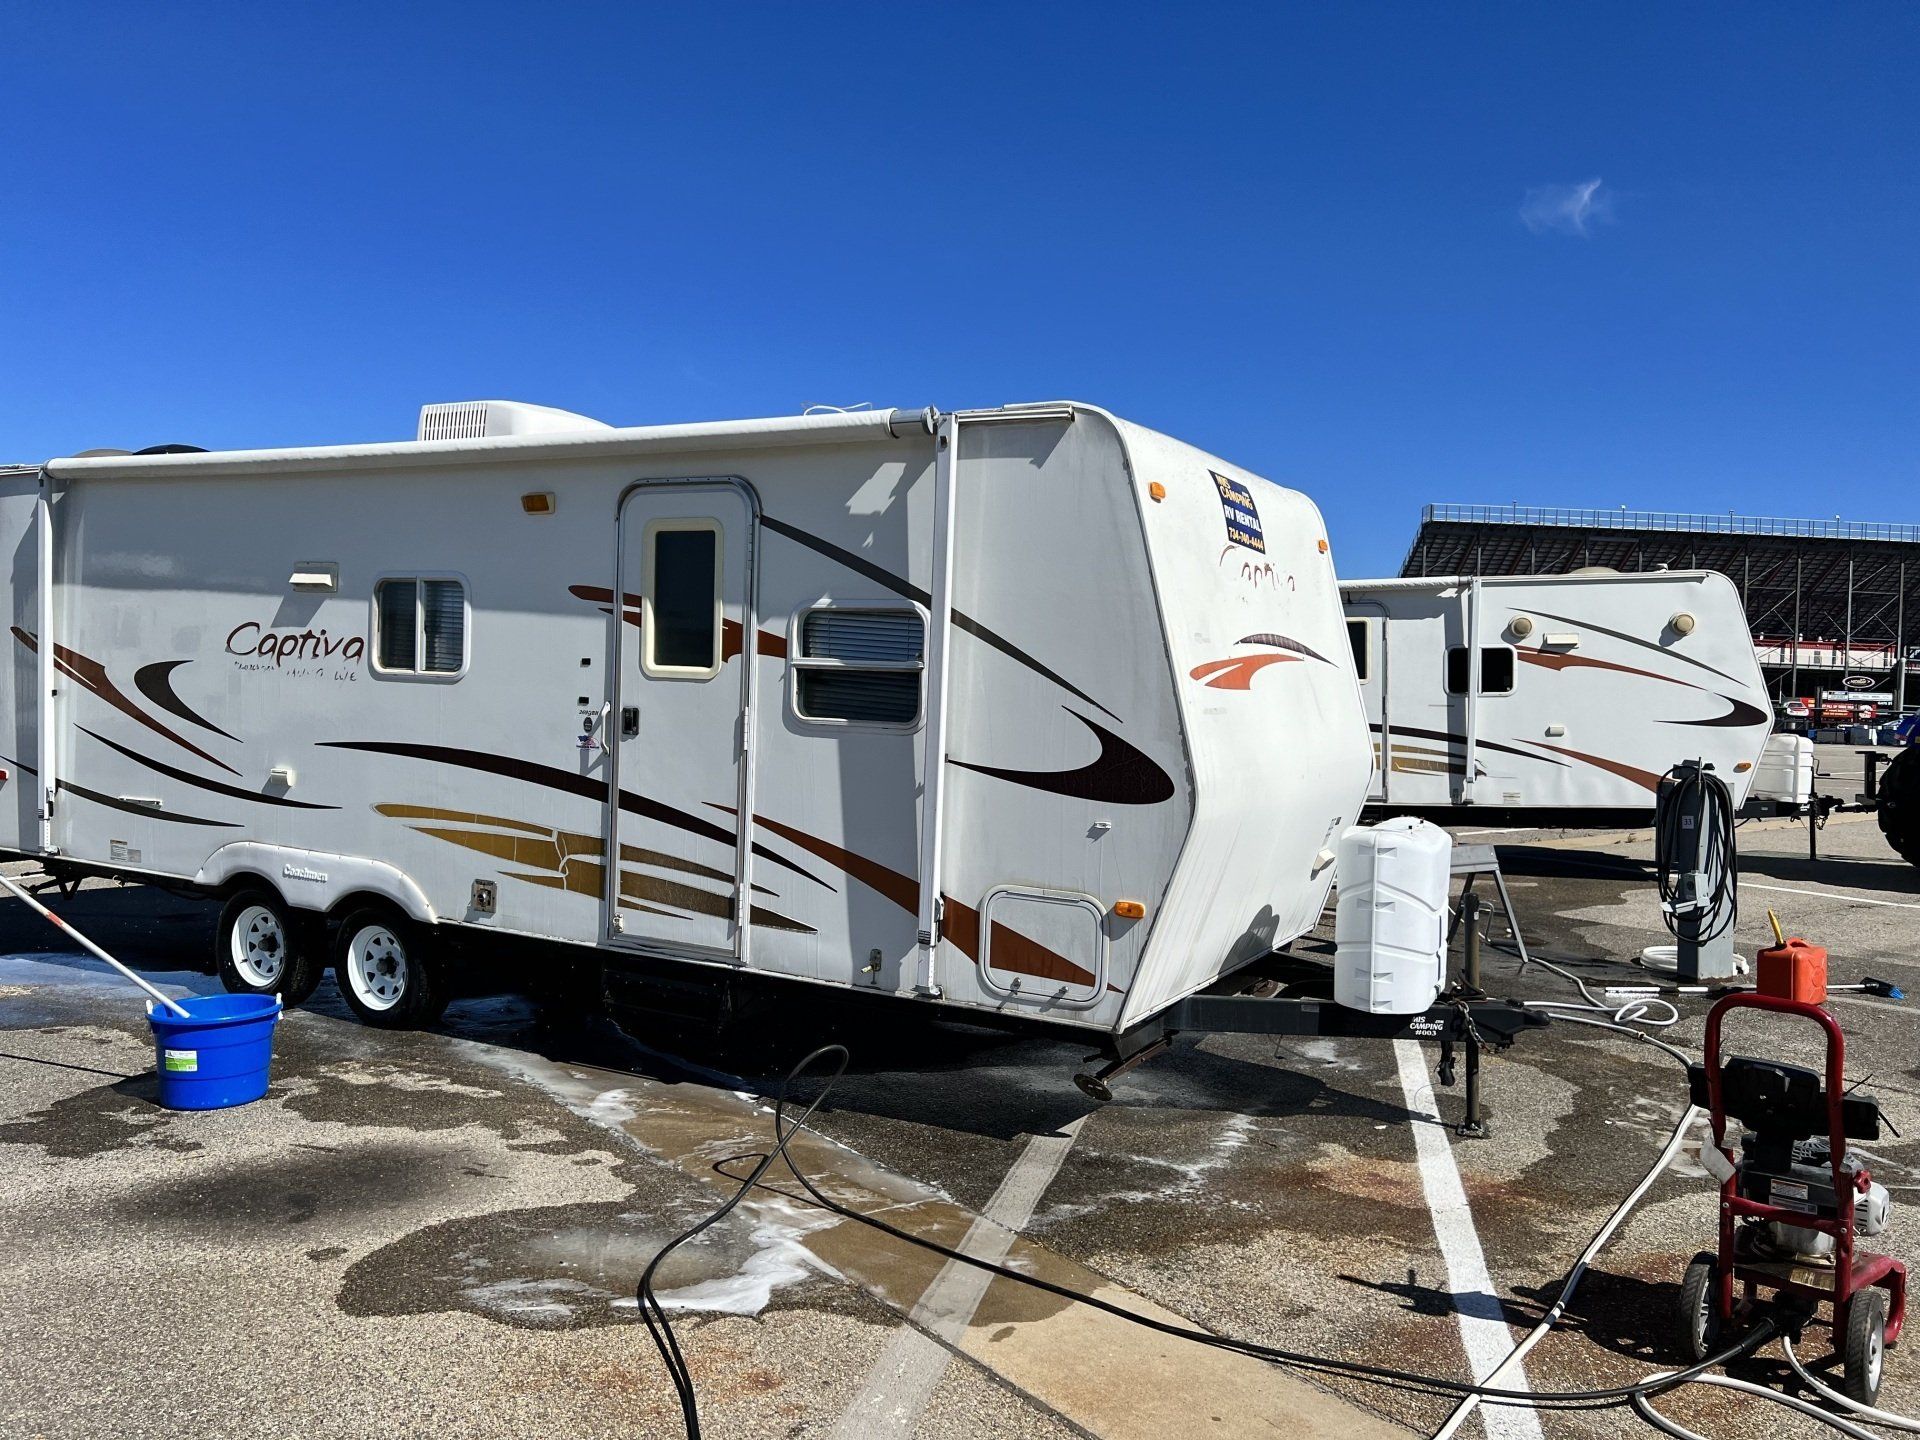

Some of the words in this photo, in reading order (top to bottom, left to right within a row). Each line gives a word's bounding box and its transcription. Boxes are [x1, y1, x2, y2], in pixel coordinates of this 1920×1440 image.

[1220, 486, 1254, 510] CAMPING
[1224, 504, 1235, 520] RV
[1235, 509, 1262, 533] RENTAL
[226, 622, 365, 667] Captiva
[1684, 818, 1692, 826] 33
[1409, 1022, 1443, 1031] CAMPING
